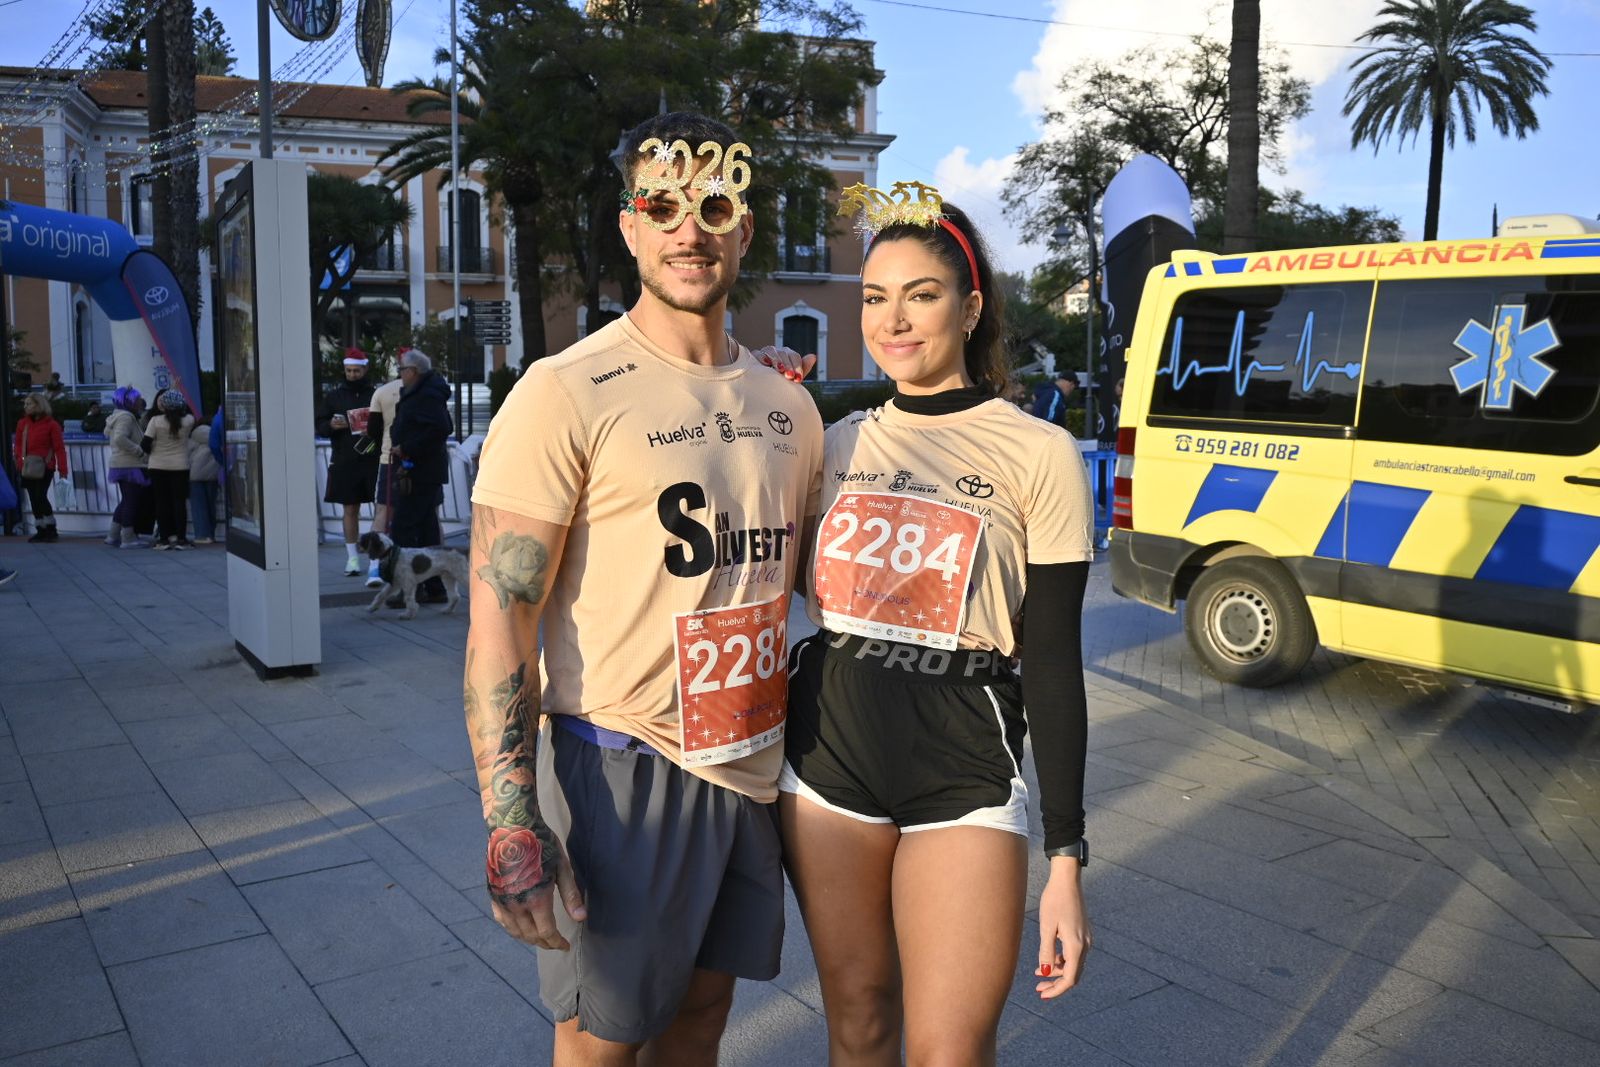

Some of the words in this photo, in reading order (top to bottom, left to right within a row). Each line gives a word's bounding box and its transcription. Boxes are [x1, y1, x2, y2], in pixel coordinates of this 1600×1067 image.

[636, 137, 752, 193] 2026
[23, 220, 110, 258] original
[1250, 241, 1534, 273] AMBULANCIA
[590, 366, 626, 385] luanvi
[647, 424, 705, 448] Huelva
[737, 430, 763, 439] HUELVA
[1195, 438, 1226, 455] 959
[1230, 440, 1259, 458] 281
[1264, 443, 1300, 461] 082
[834, 470, 879, 483] Huelva
[1373, 458, 1536, 482] ambulanciastranscabello@gmail.com
[907, 485, 938, 494] HUELVA
[867, 500, 894, 511] Huelva
[822, 512, 962, 581] 2284
[717, 616, 746, 628] Huelva
[687, 620, 787, 696] 2282
[854, 638, 951, 675] PRO
